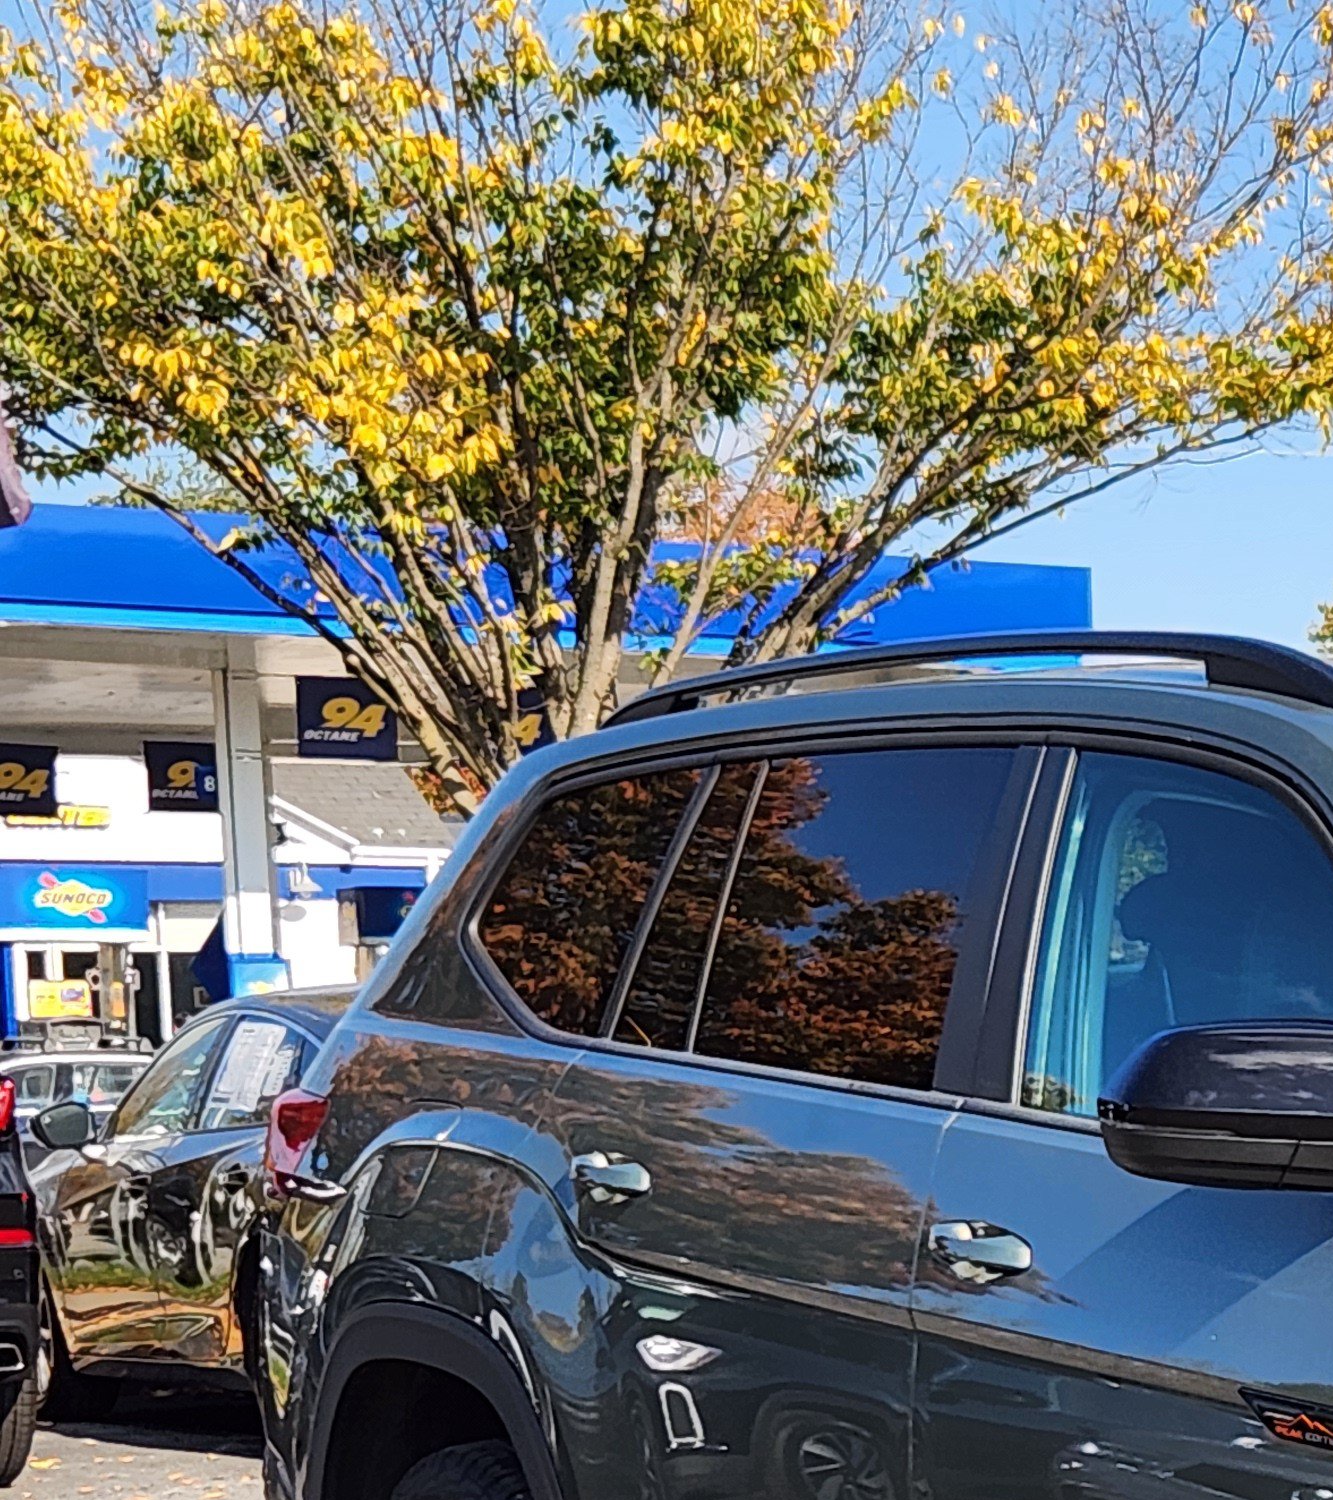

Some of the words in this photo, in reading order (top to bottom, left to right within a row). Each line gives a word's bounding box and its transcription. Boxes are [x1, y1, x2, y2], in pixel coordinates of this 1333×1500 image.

[322, 696, 386, 737] 94
[303, 729, 359, 742] OCTANE
[0, 762, 49, 798] 94
[166, 760, 197, 788] 9
[41, 892, 107, 905] SUNOCO
